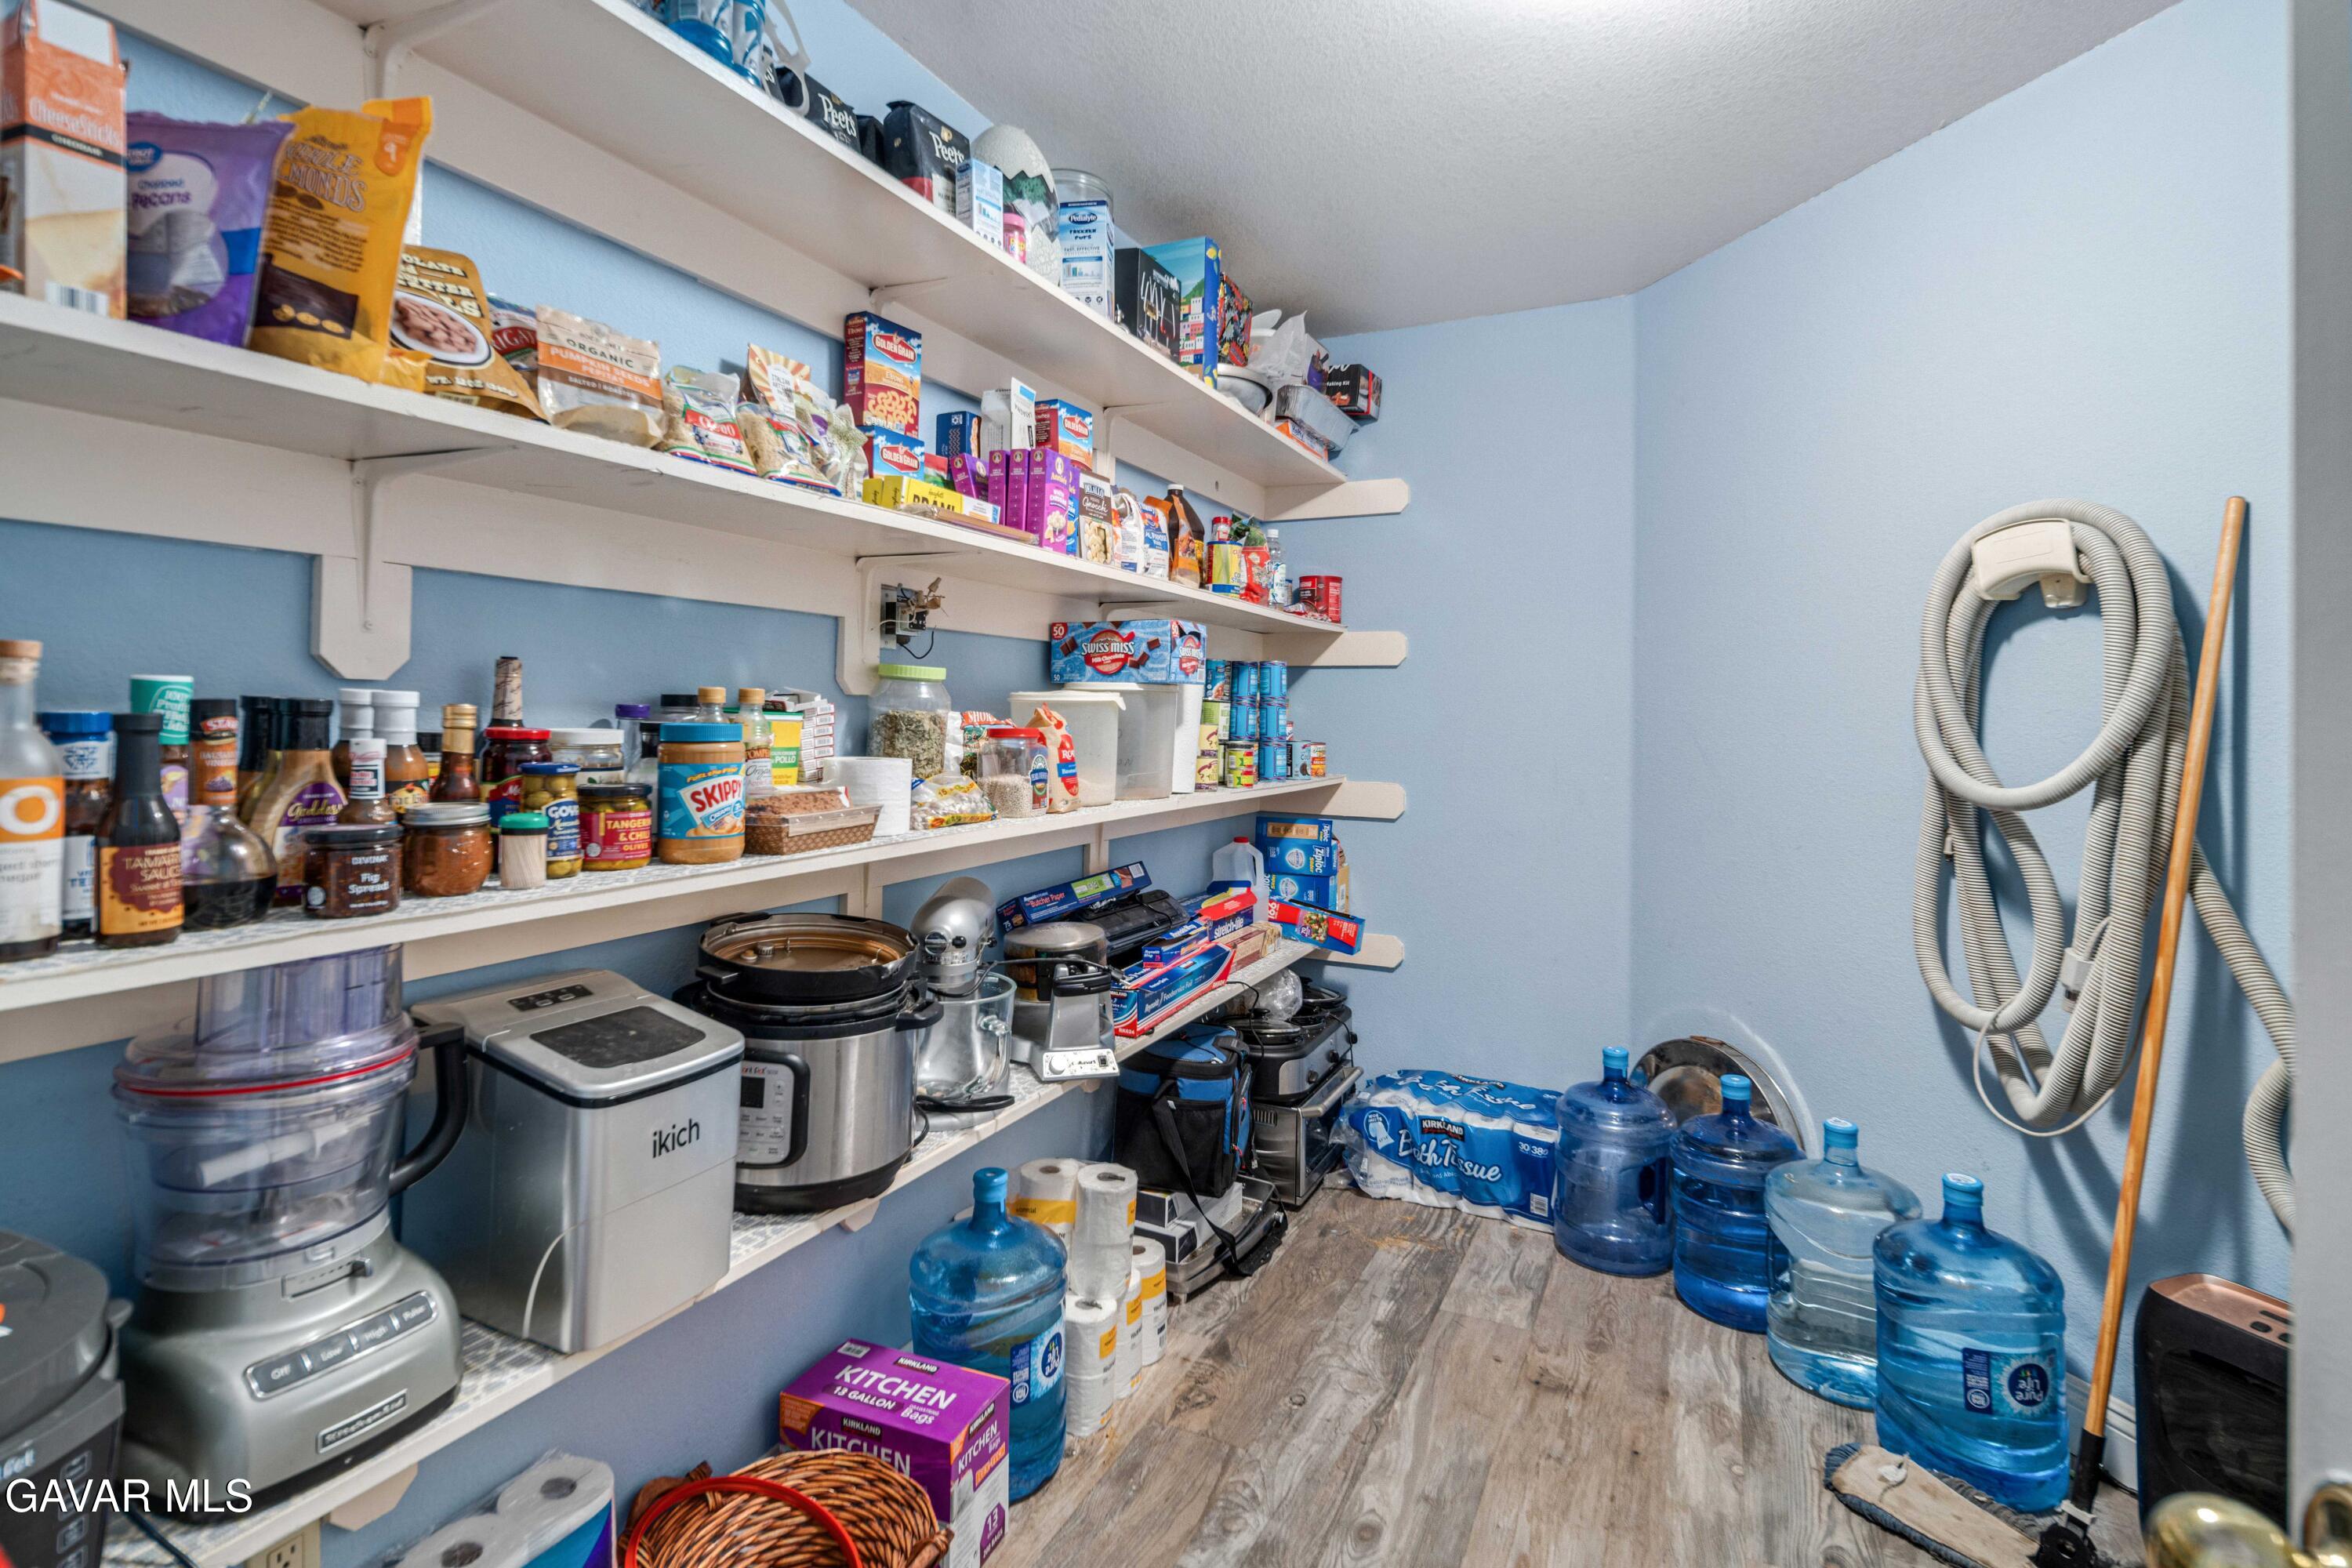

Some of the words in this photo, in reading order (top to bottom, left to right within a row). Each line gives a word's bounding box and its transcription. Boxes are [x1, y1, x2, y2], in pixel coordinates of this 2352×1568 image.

[818, 93, 857, 138] Peet's
[1069, 212, 1098, 224] Pedialyte
[567, 338, 634, 368] ORGANIC
[883, 448, 903, 464] GOLDEN
[1083, 496, 1108, 513] Gnocchi
[1053, 626, 1065, 636] 50
[690, 779, 742, 812] SKIPPY
[547, 804, 579, 818] GOY
[619, 832, 628, 841] &
[1314, 846, 1325, 873] Ziploc
[361, 873, 381, 884] Fig
[348, 881, 390, 895] Spread
[1145, 998, 1160, 1013] Reynolds
[1422, 1120, 1464, 1135] KIRKLAND
[652, 1118, 700, 1159] ikich
[1398, 1129, 1442, 1167] Bath
[1442, 1139, 1501, 1182] Tissue
[321, 1347, 343, 1362] Low
[270, 1365, 291, 1380] Off
[898, 1356, 938, 1373] KIRKLAND
[834, 1364, 956, 1410] KITCHEN
[2017, 1377, 2040, 1390] Life
[833, 1385, 847, 1396] 13
[848, 1390, 896, 1410] GALLON
[2015, 1389, 2044, 1402] Pure
[901, 1406, 935, 1425] Bags
[970, 1403, 995, 1434] KIRKLAND
[843, 1417, 881, 1436] KIRKLAND
[958, 1421, 997, 1474] KITCHEN
[986, 1507, 999, 1531] 13
